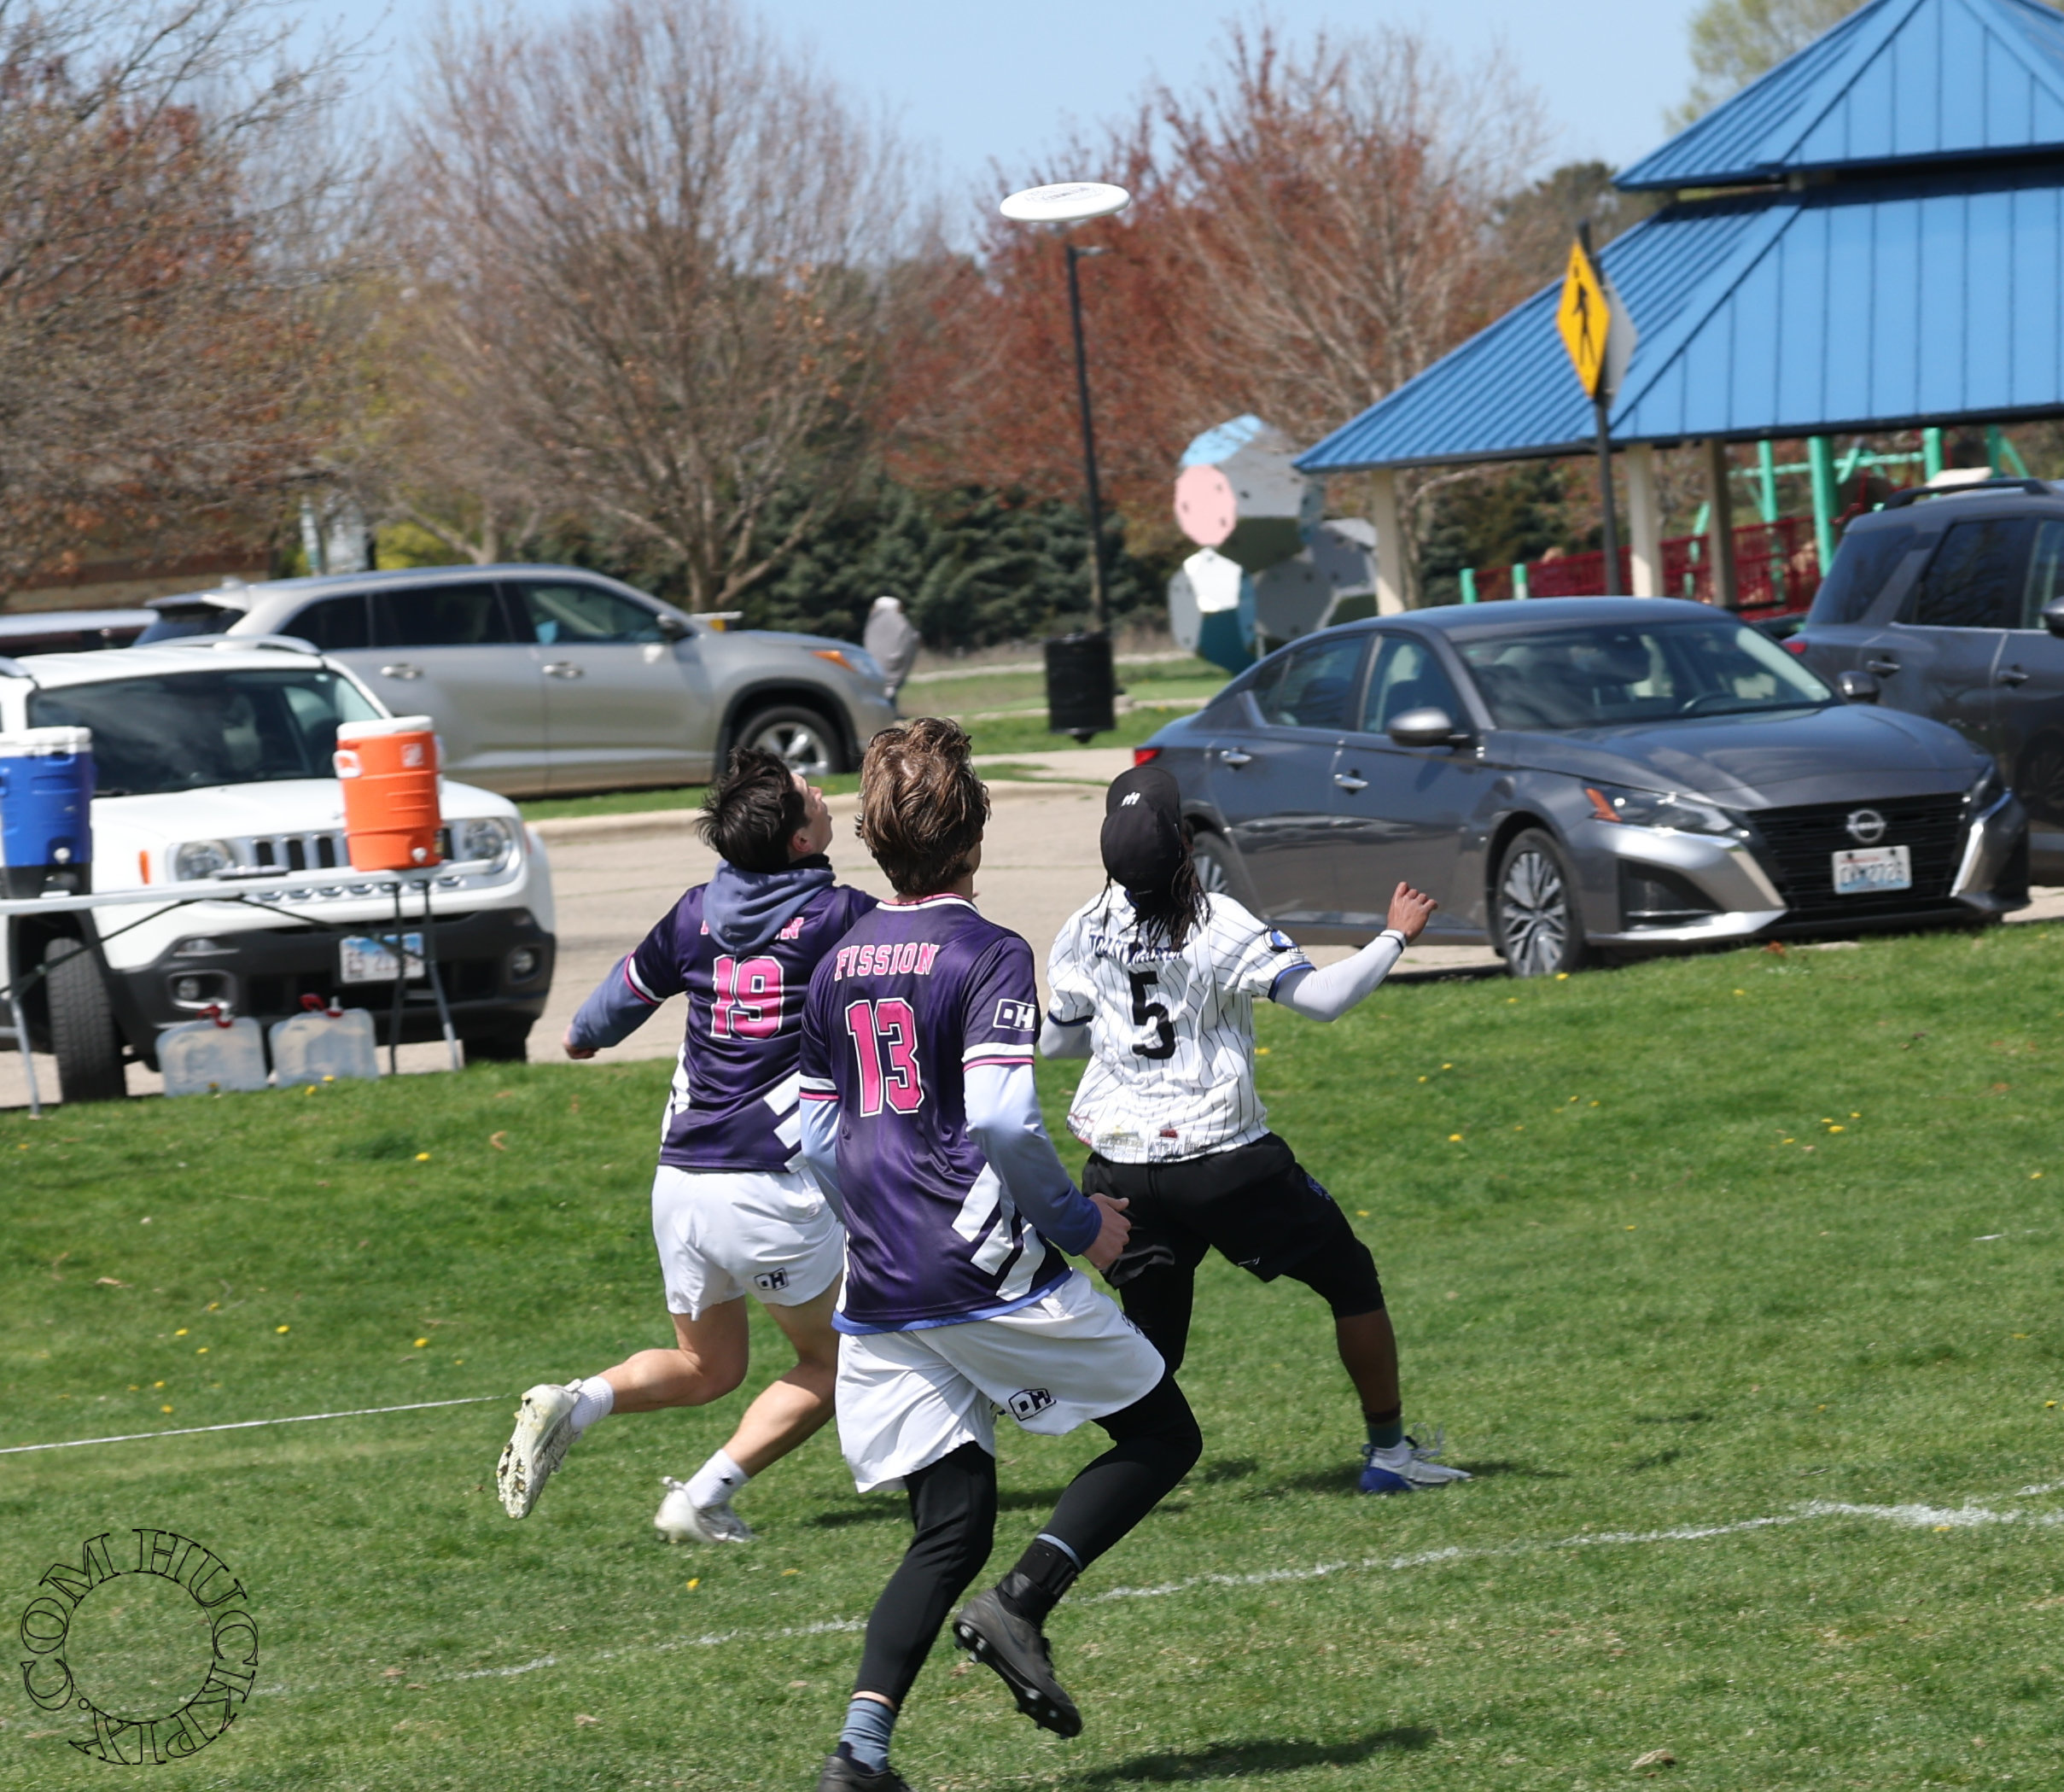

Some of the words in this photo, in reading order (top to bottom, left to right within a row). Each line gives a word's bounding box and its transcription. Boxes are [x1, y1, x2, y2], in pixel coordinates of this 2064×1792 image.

[710, 954, 784, 1041] 19
[834, 943, 940, 982] FISSION
[845, 997, 924, 1118] 13
[1128, 970, 1176, 1059] 5
